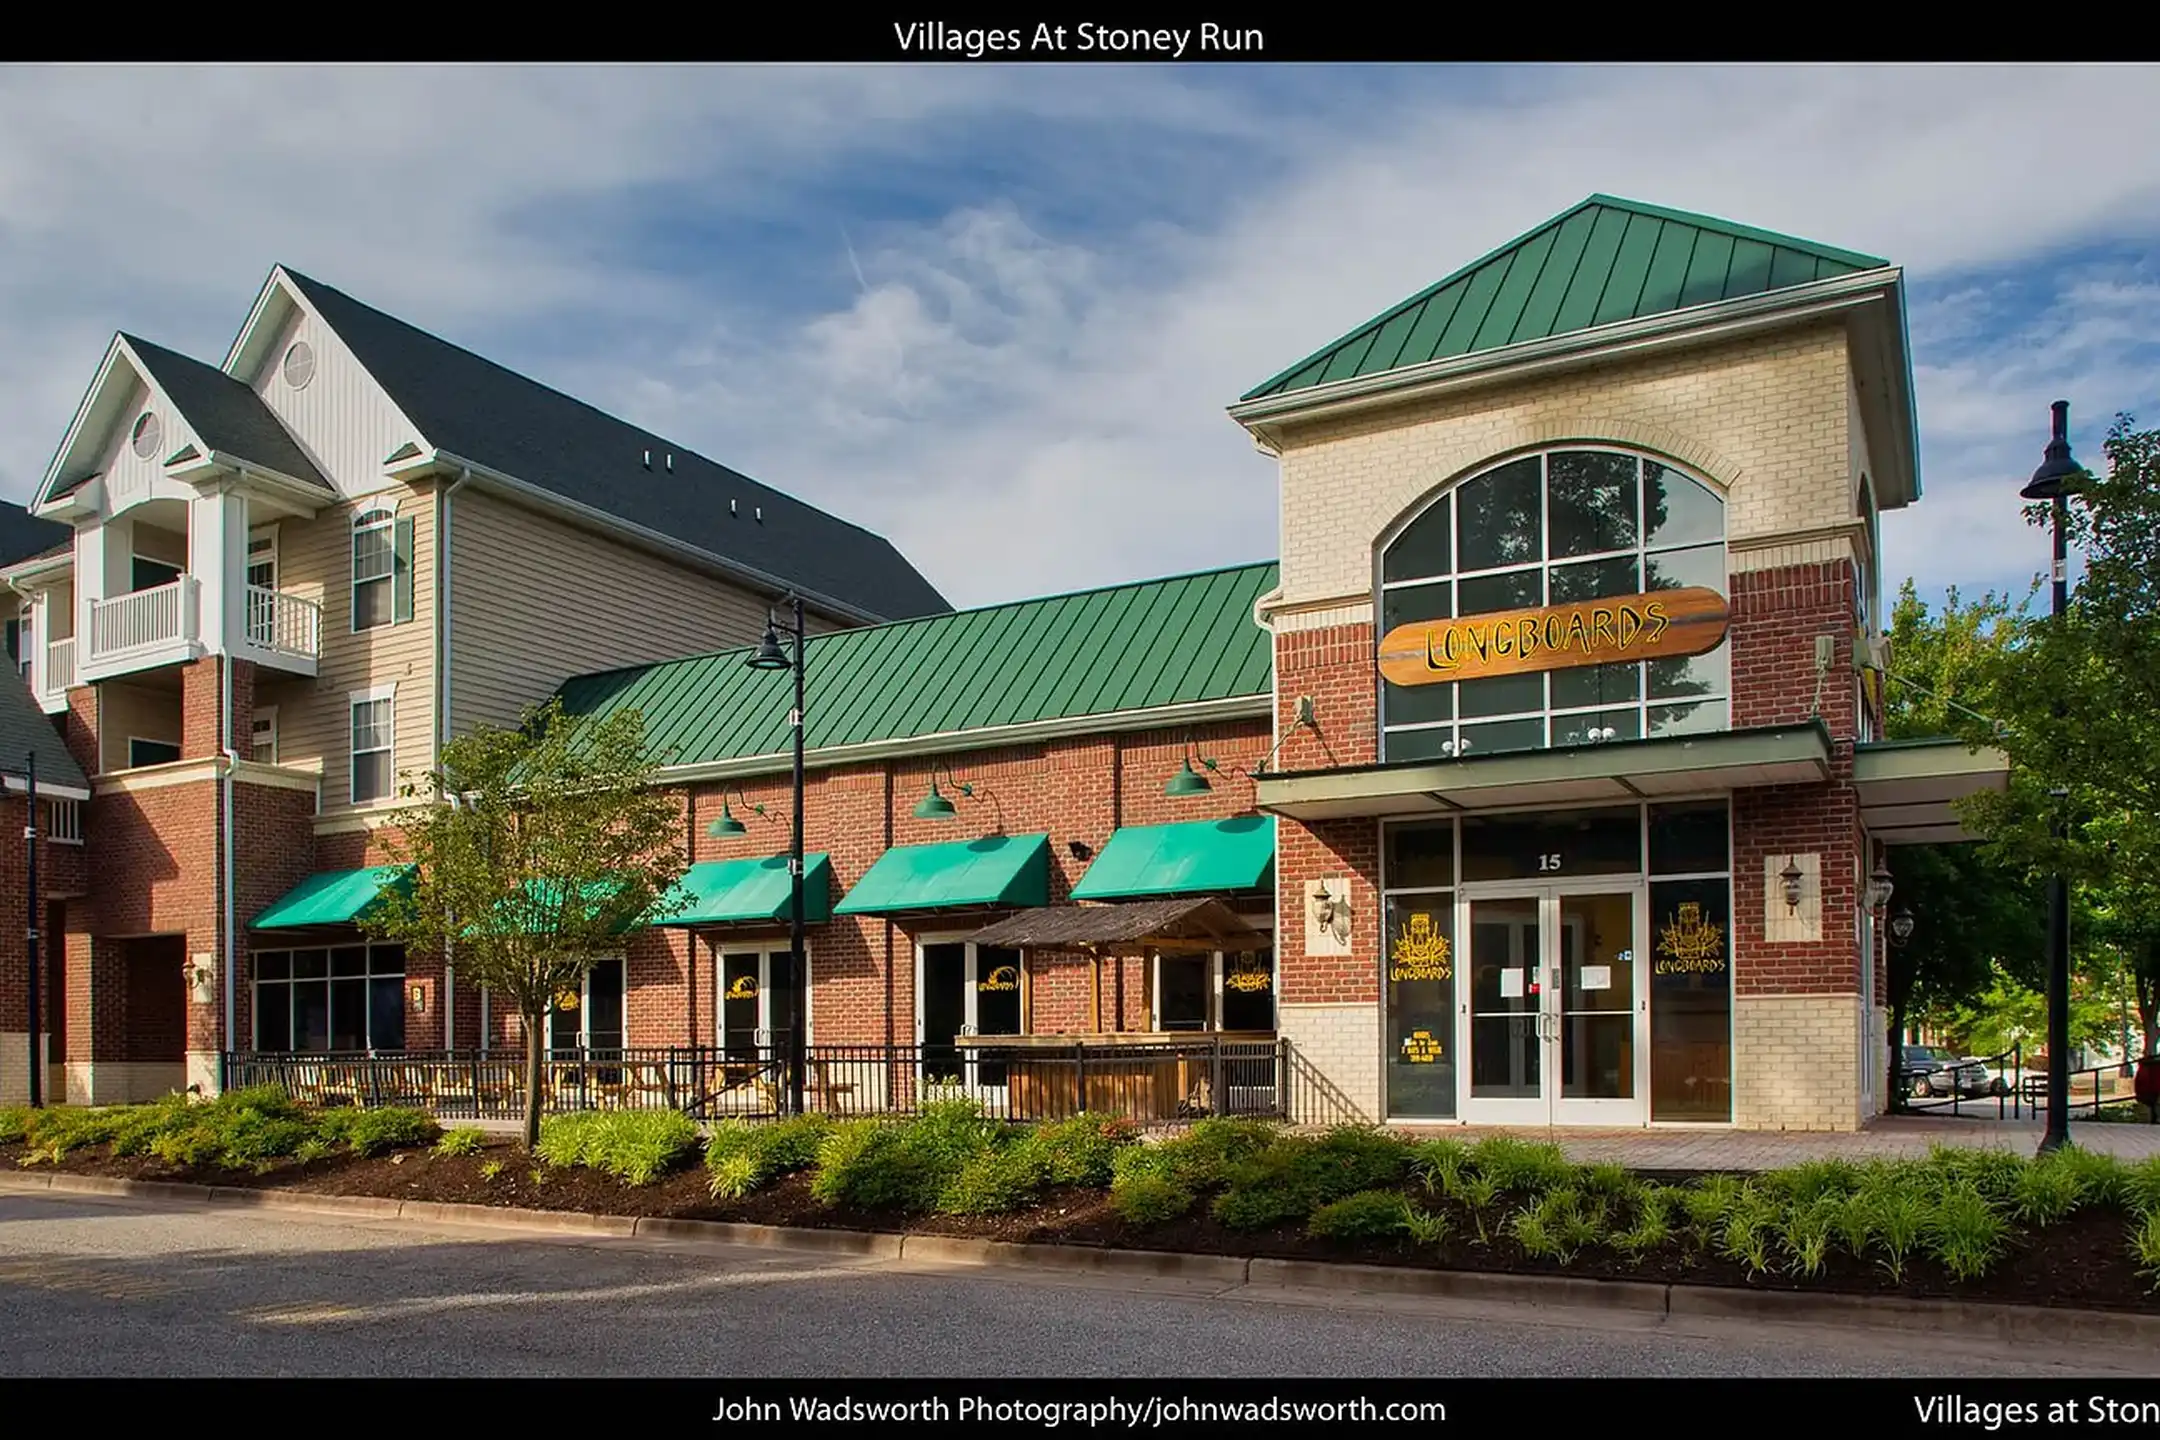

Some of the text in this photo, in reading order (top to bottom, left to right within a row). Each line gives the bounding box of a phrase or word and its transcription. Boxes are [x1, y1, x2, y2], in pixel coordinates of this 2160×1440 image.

[1425, 601, 1669, 672] LONGBOARDS
[1538, 853, 1562, 871] 15
[1390, 966, 1452, 982] LONGBOARDS
[1654, 959, 1726, 975] LONGBOARDS
